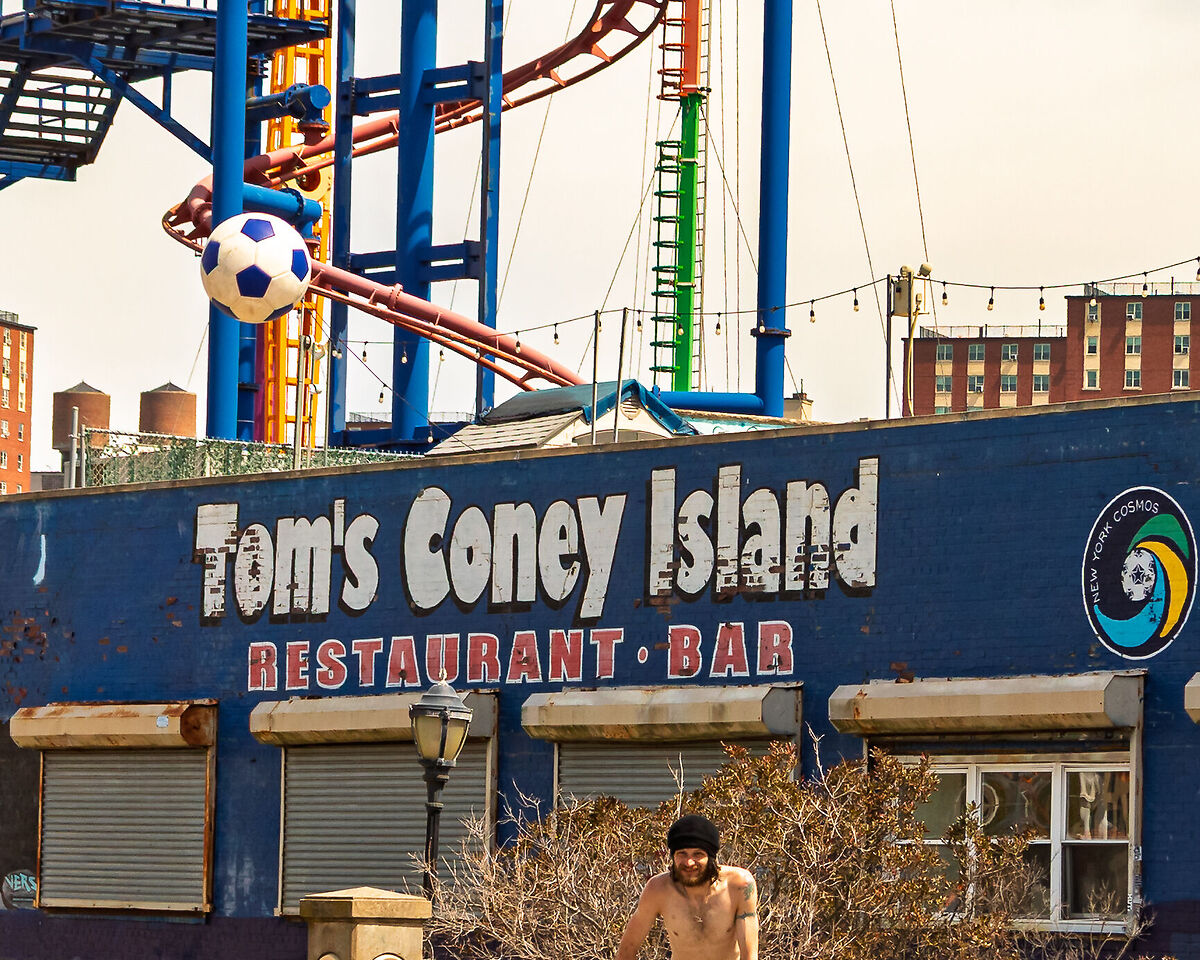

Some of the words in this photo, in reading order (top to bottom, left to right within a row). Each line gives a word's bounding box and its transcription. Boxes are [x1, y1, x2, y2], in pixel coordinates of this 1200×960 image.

[1113, 500, 1159, 522] COSMOS
[195, 499, 380, 621] Tom's
[403, 486, 628, 621] Coney
[647, 457, 880, 598] Island
[1092, 522, 1113, 561] YORK
[1090, 568, 1100, 603] NEW
[246, 627, 625, 692] RESTAURANT
[666, 620, 796, 679] BAR
